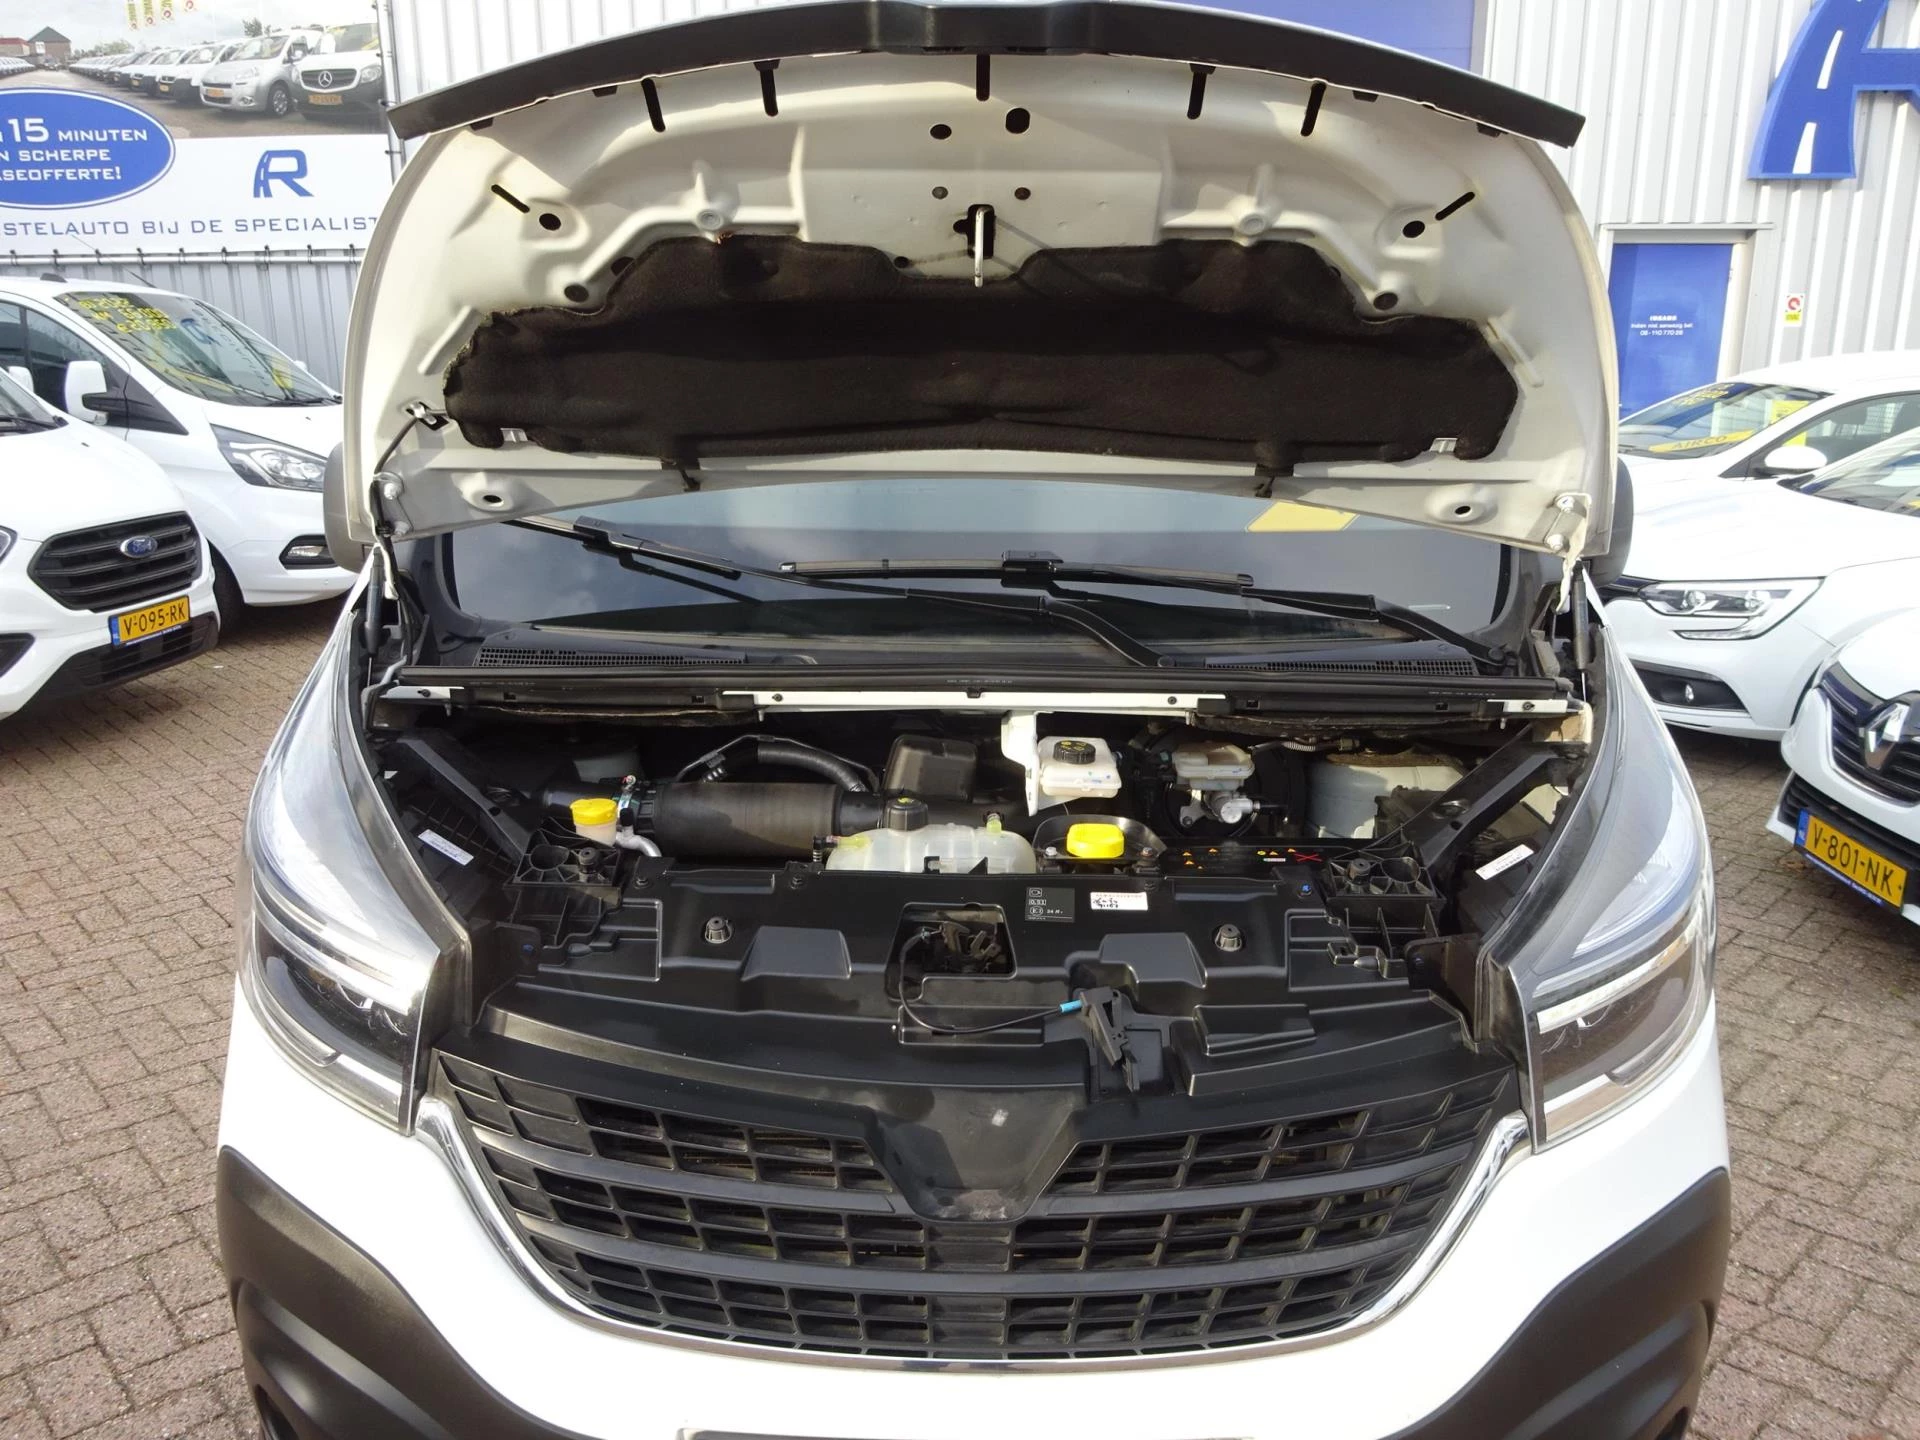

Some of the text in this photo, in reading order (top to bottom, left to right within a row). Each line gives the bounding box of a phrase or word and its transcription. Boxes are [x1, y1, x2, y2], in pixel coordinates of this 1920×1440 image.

[8, 118, 49, 142] 15
[58, 129, 148, 142] MINUTEN
[18, 149, 112, 162] SCHERPE
[0, 166, 122, 181] SEOFFERTE!
[3, 221, 129, 236] STELAUTO
[142, 220, 179, 235] BIJ
[191, 219, 223, 234] DE
[123, 602, 186, 636] V-095-RK
[1812, 823, 1894, 897] V-801-NK
